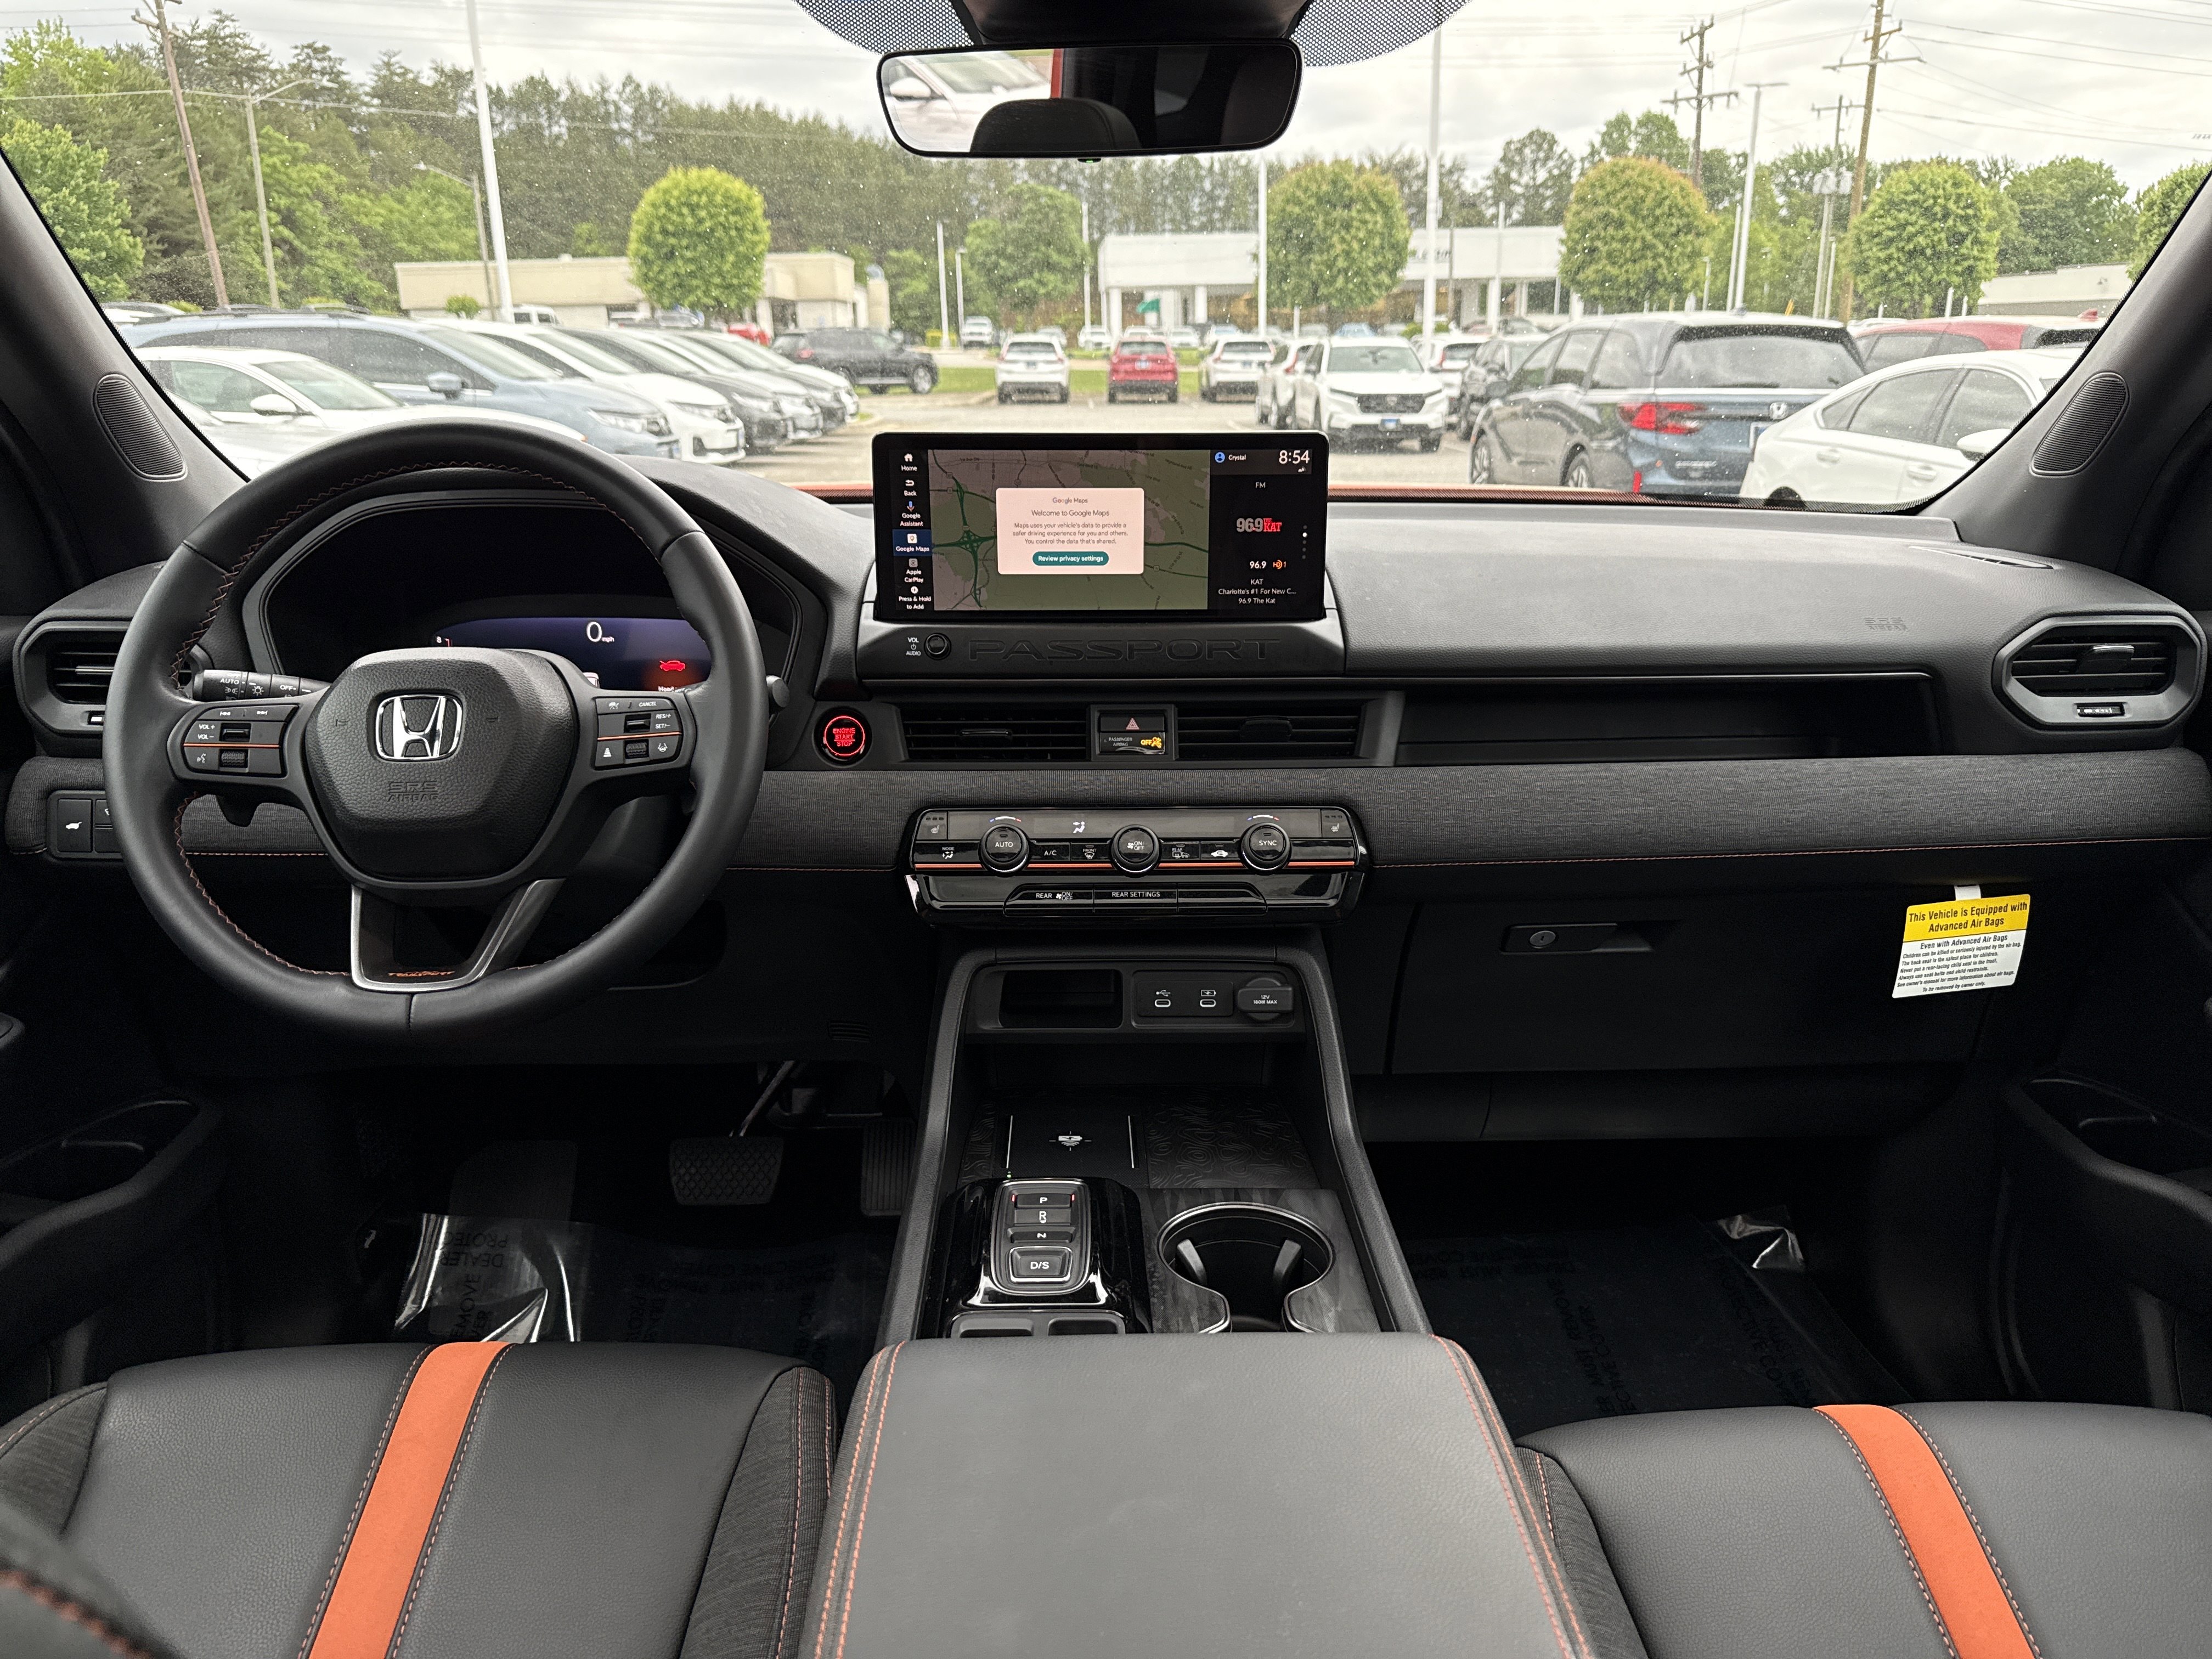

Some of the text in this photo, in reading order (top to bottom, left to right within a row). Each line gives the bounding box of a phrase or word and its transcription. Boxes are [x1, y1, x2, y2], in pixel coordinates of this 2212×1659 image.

[1279, 450, 1310, 464] 8:54
[1263, 522, 1282, 532] KAT
[586, 621, 602, 642] 0
[969, 639, 1280, 661] PASSPORT
[388, 781, 439, 792] SRS
[387, 793, 440, 802] AIRBAG
[1909, 902, 2028, 922] This Vehicle is Equipped with
[1928, 917, 2005, 933] Advanced Air Bags
[1920, 941, 1934, 950] Even
[1937, 939, 1950, 947] with
[1951, 937, 1980, 946] Advanced
[1039, 1211, 1047, 1220] R
